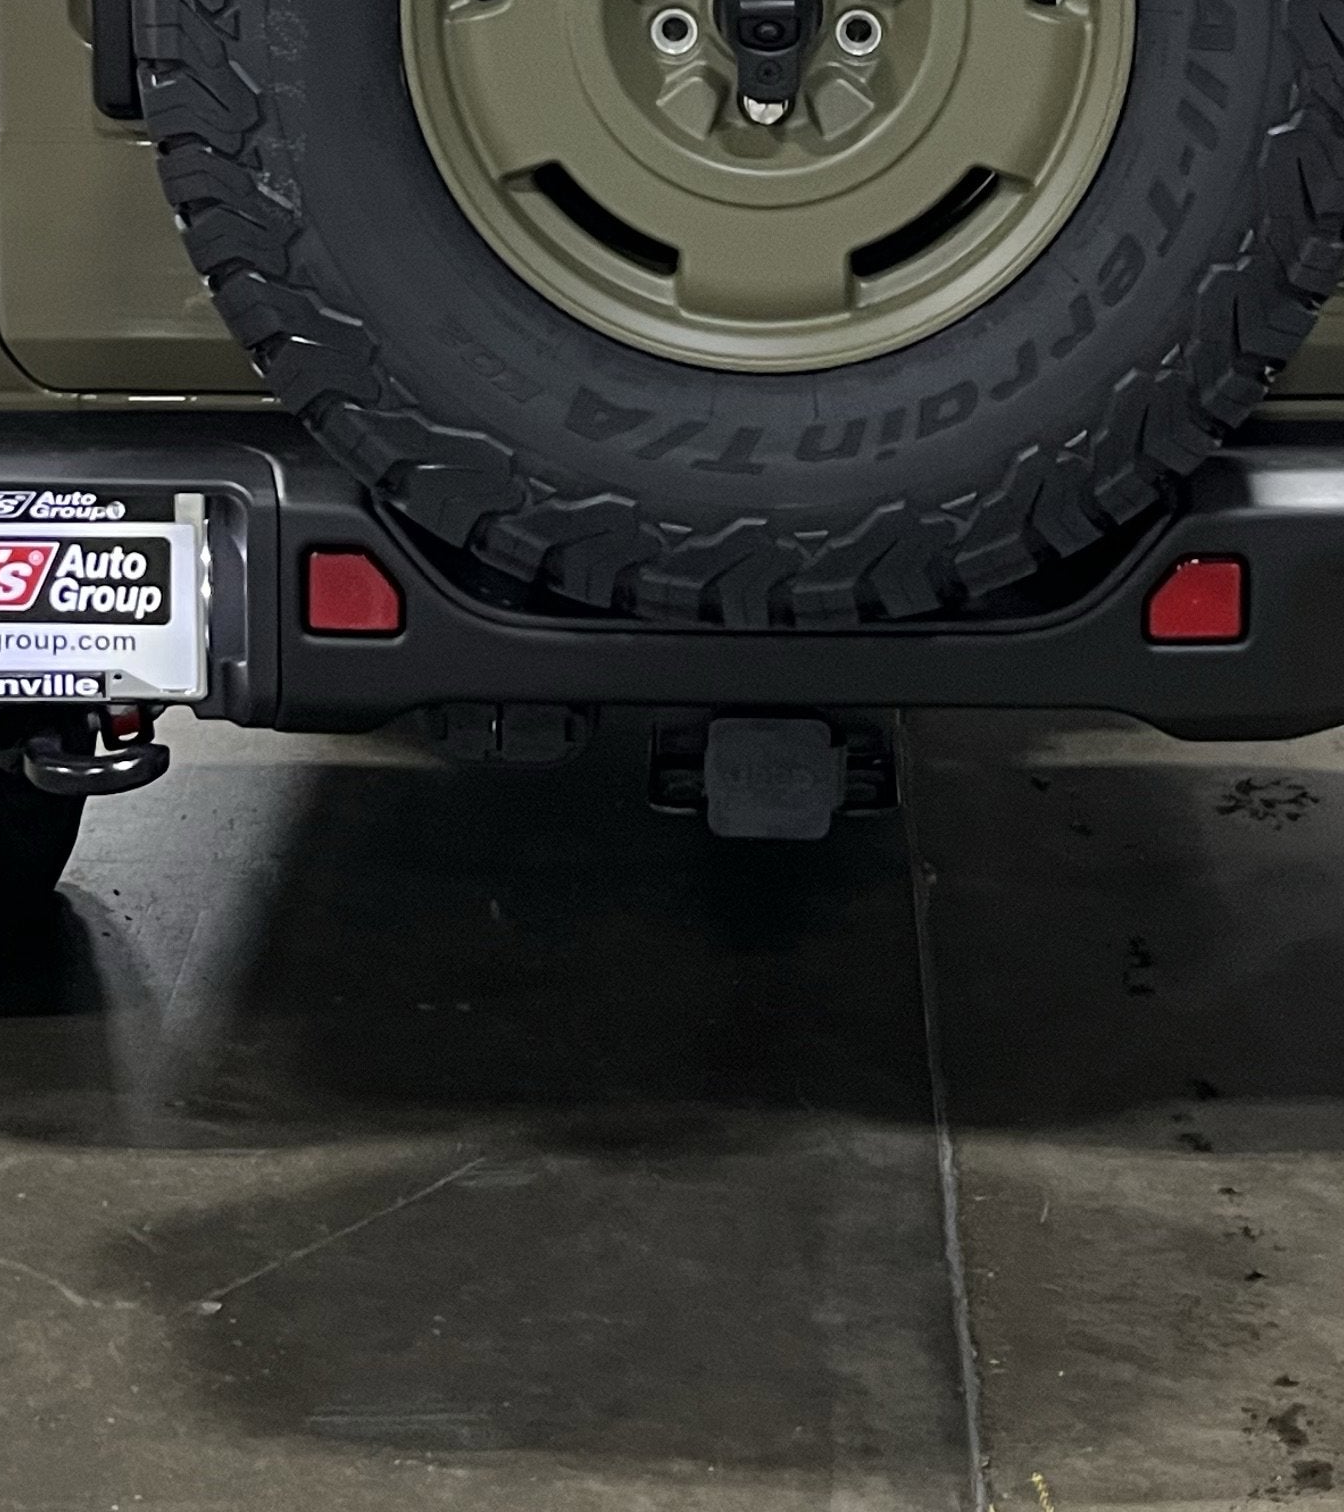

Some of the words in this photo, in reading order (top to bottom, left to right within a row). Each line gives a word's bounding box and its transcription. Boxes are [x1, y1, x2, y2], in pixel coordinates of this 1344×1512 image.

[40, 490, 98, 507] Auto
[29, 505, 108, 522] Group
[55, 543, 149, 580] Auto
[48, 577, 163, 621] Group
